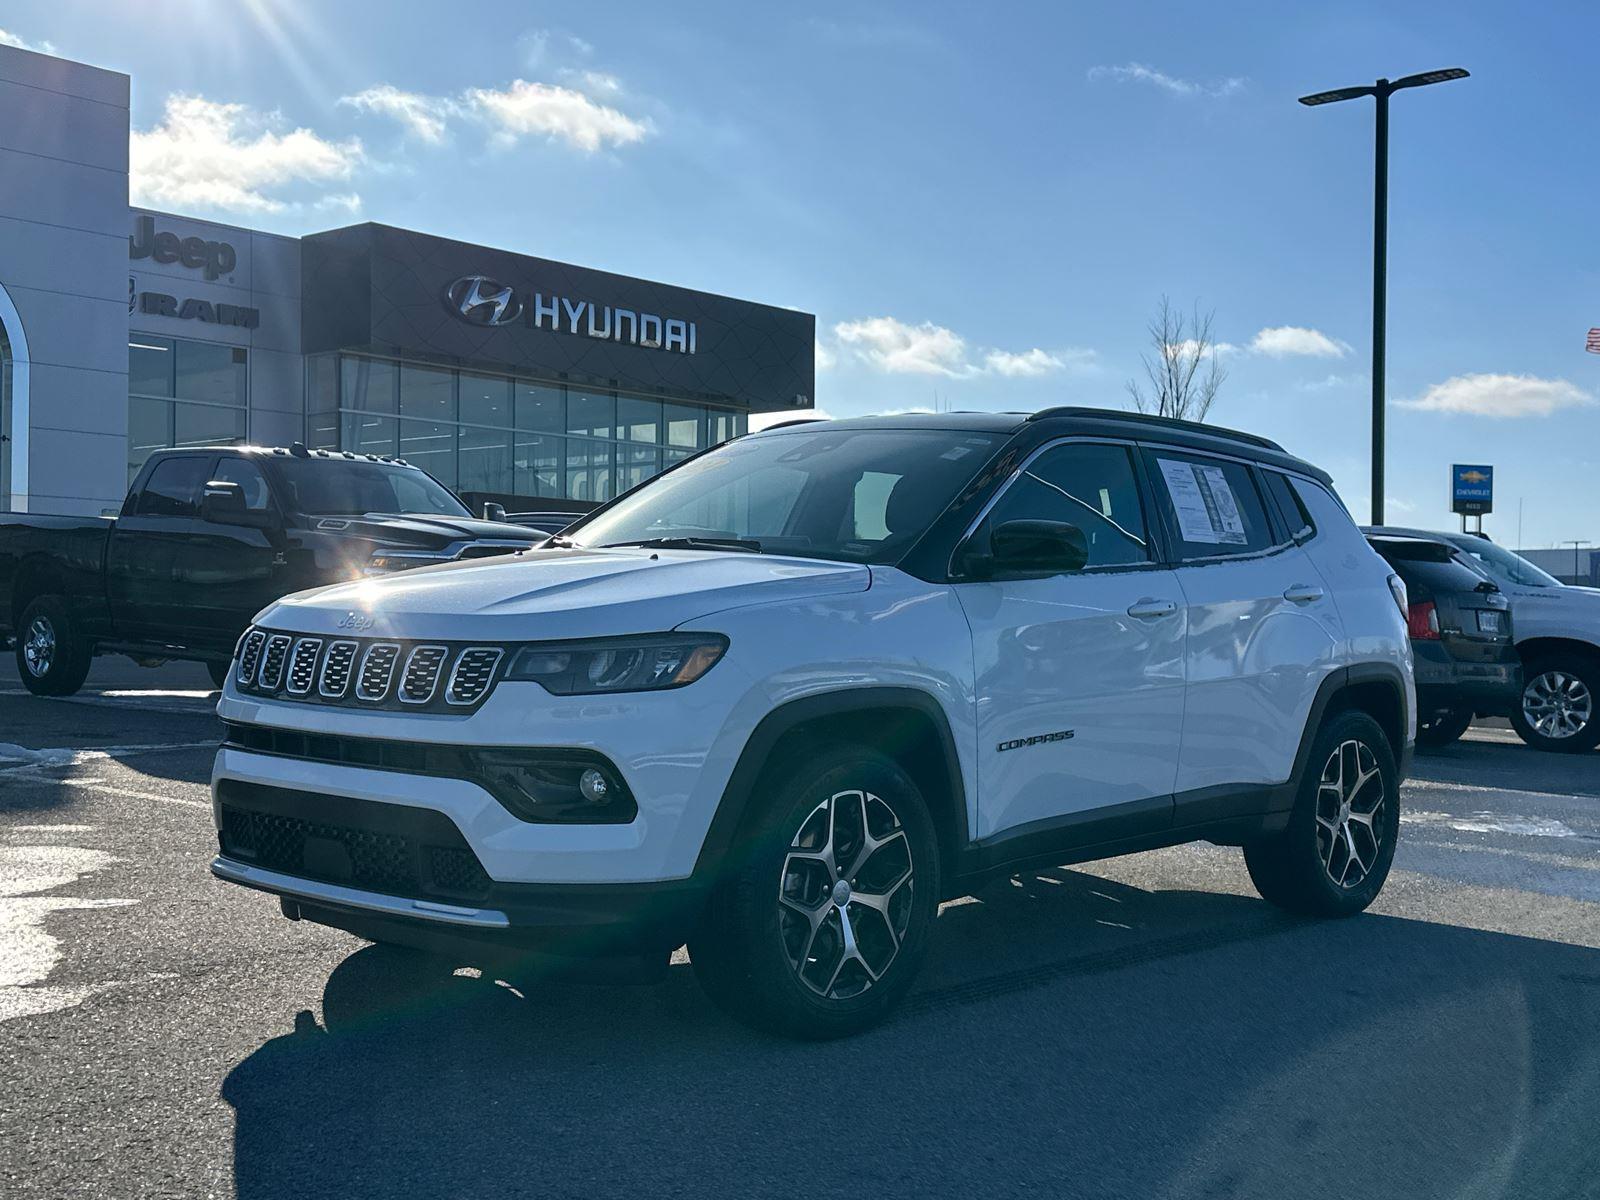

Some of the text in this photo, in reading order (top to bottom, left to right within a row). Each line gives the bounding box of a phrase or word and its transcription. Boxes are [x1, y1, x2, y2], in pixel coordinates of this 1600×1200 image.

[129, 216, 236, 281] Jeep
[140, 291, 260, 329] RAM
[534, 293, 697, 355] HYUNDAI
[336, 611, 375, 632] Jeep
[996, 729, 1075, 752] COMPASS
